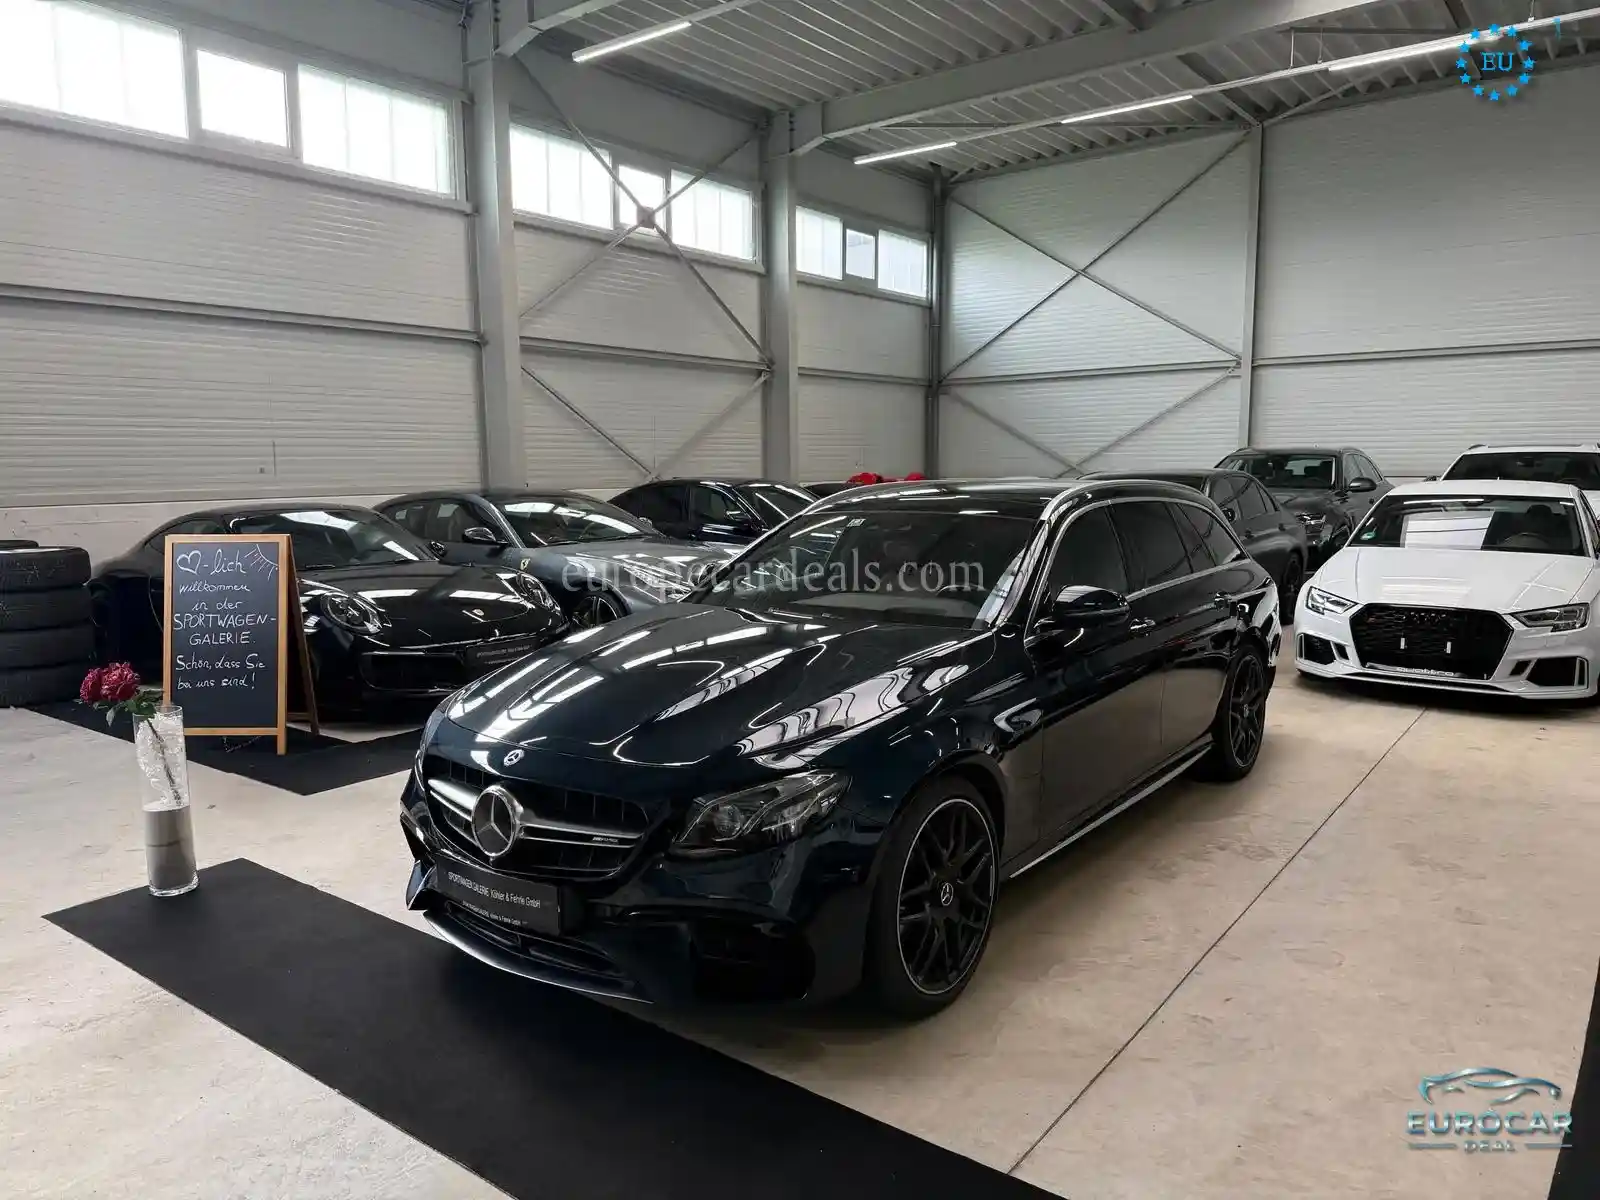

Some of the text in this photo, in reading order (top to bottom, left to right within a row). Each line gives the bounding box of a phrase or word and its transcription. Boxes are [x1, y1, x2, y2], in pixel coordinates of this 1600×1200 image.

[179, 580, 251, 595] willkommen
[191, 597, 243, 612] in der
[173, 613, 277, 630] SPORTWAGEN-
[175, 652, 266, 671] Schön, dass Sie
[1396, 666, 1455, 677] quattro
[195, 679, 216, 687] uns
